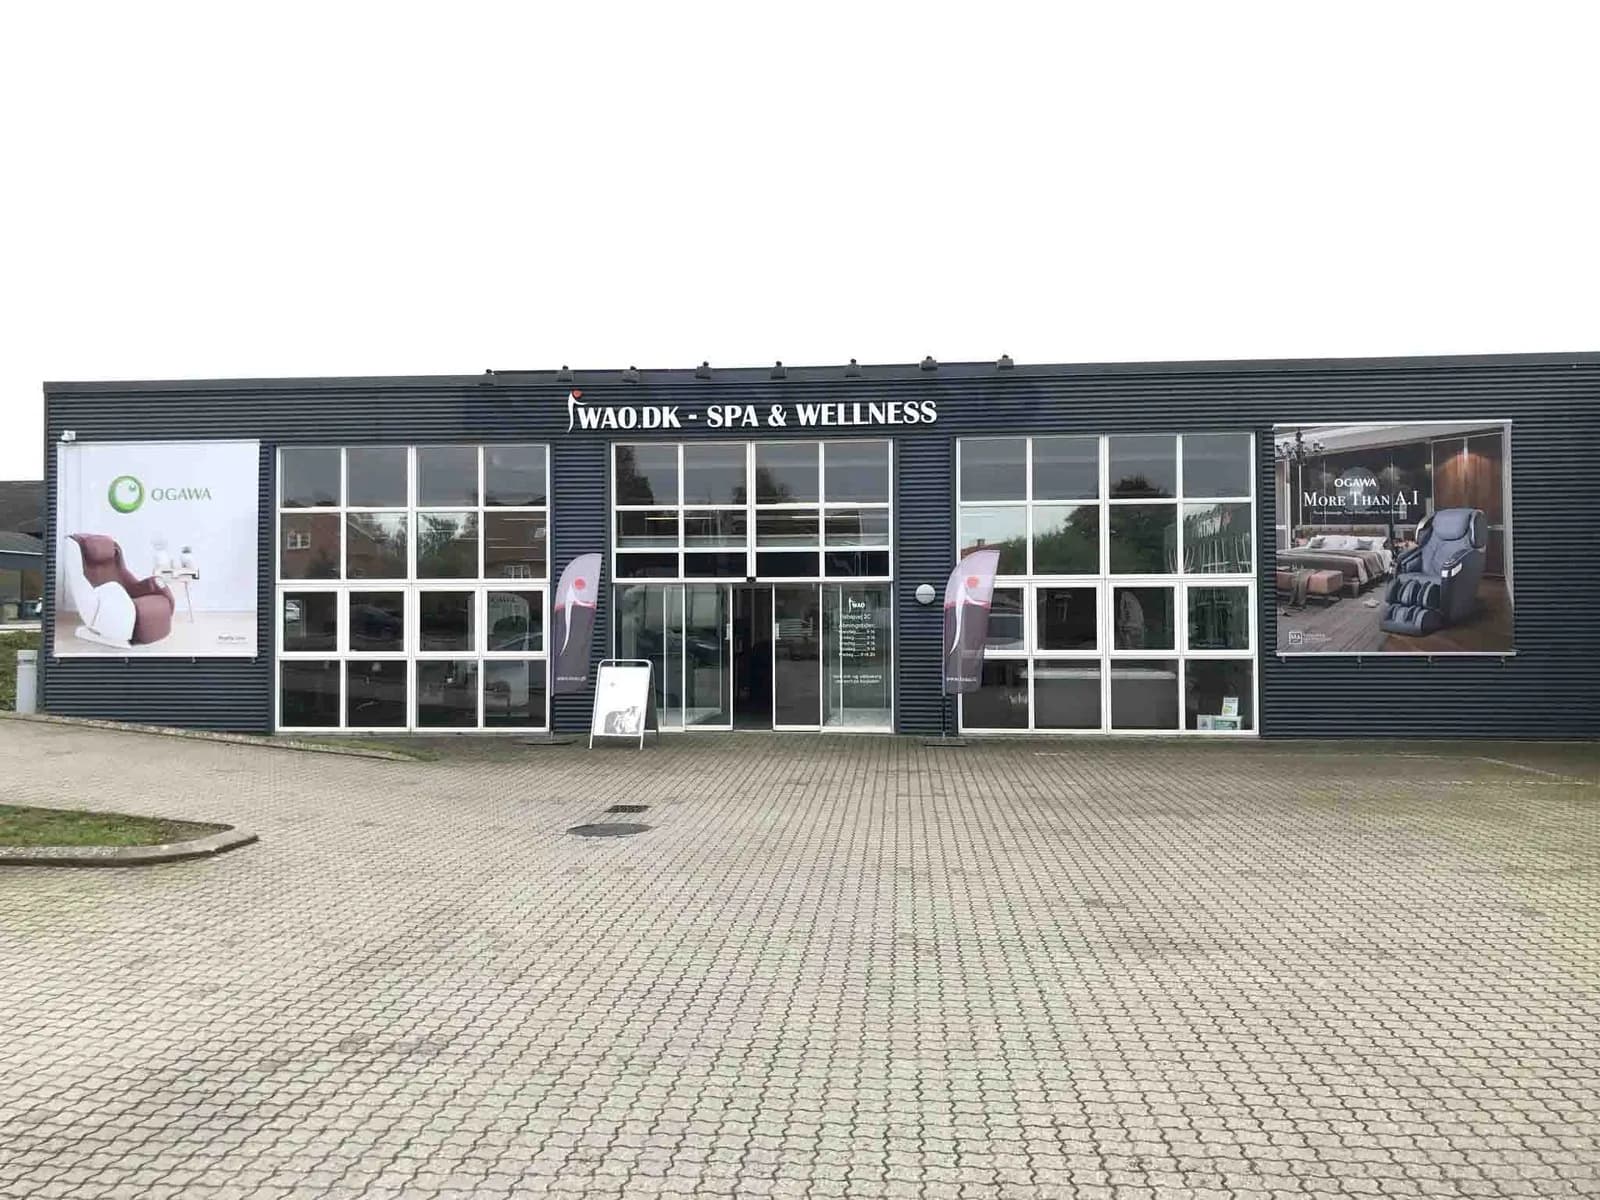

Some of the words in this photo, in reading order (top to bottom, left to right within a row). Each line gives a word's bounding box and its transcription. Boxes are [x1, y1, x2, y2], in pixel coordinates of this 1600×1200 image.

[577, 406, 682, 429] WAO.DK
[707, 405, 760, 428] SPA
[767, 404, 787, 427] &
[796, 400, 937, 426] WELLNESS
[1334, 478, 1377, 488] OGAWA
[151, 487, 212, 501] OGAWA
[1395, 490, 1419, 506] A.I
